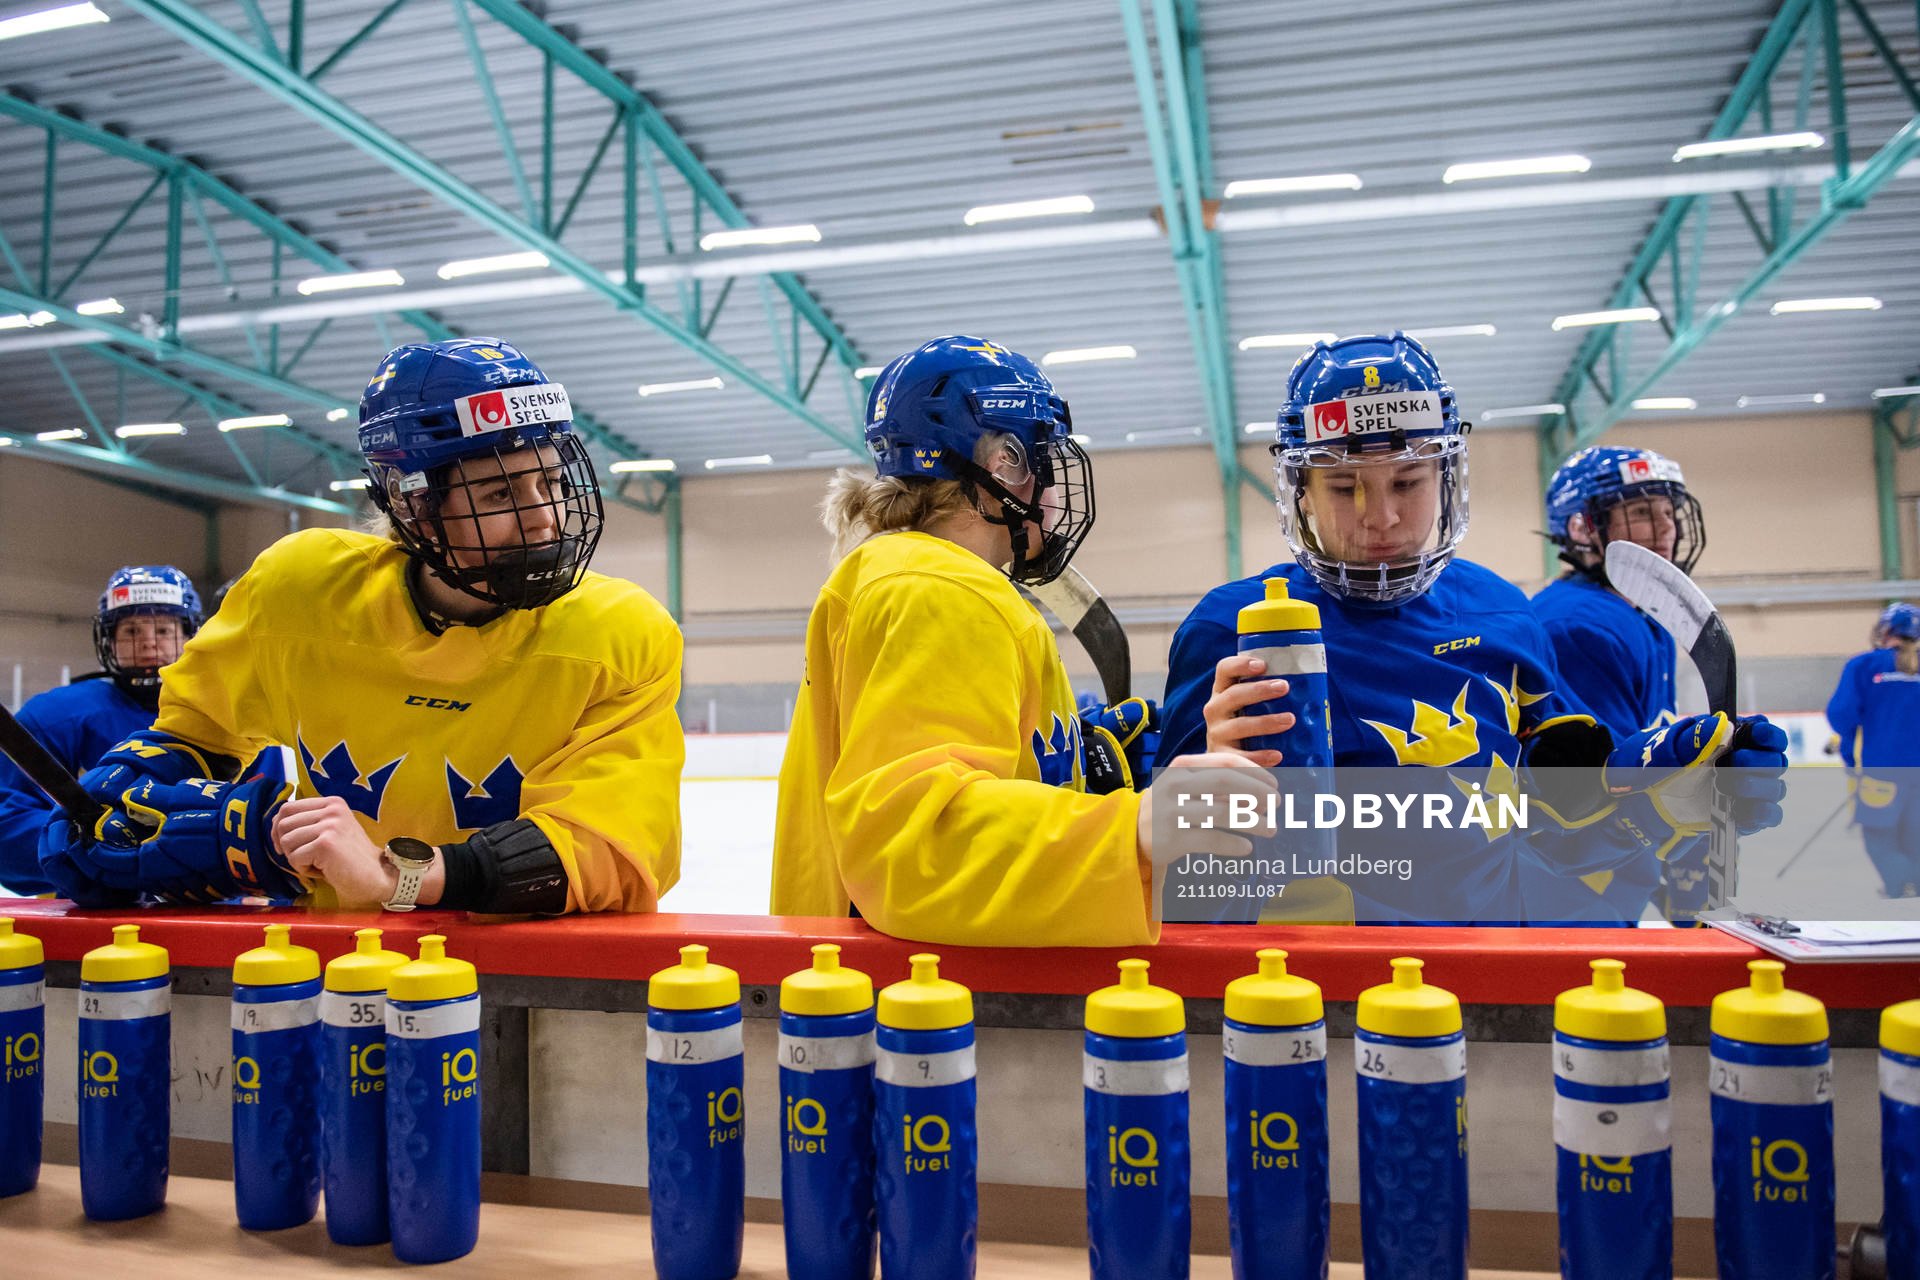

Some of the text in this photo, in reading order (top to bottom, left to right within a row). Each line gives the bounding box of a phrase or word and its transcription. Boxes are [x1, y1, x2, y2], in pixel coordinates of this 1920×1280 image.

[1363, 366, 1381, 387] 8
[1340, 382, 1401, 399] CCM
[982, 399, 1027, 409] CCM
[1353, 399, 1431, 418] SVENSKA
[514, 408, 551, 425] SPEL
[1355, 417, 1397, 433] SPEL
[1002, 496, 1028, 515] CCM
[1433, 635, 1480, 655] CCM
[404, 695, 472, 712] CCM
[1096, 745, 1113, 772] CCM
[1621, 818, 1653, 847] CCM
[242, 1009, 259, 1026] 19.
[350, 1003, 382, 1024] 35.
[397, 1014, 420, 1033] 15.
[5, 1032, 40, 1065] iQ
[674, 1038, 702, 1060] 12.
[789, 1045, 811, 1065] 10.
[1290, 1040, 1312, 1059] 25
[6, 1062, 39, 1083] fuel
[83, 1050, 119, 1082] iQ
[442, 1047, 478, 1087] iQ
[917, 1060, 934, 1079] 9.
[1362, 1049, 1393, 1076] 26.
[84, 1083, 118, 1099] fuel
[351, 1079, 385, 1096] fue
[443, 1082, 477, 1107] fuel
[707, 1087, 742, 1127] iQ
[787, 1095, 828, 1136] iQ
[709, 1122, 742, 1148] fuel
[903, 1114, 951, 1153] iQ
[1250, 1110, 1300, 1150] iQ
[788, 1135, 826, 1154] fuel
[1108, 1125, 1159, 1168] iQ
[904, 1154, 950, 1175] fuel
[1252, 1151, 1299, 1169] fuel
[1751, 1136, 1810, 1182] iQ
[1110, 1167, 1158, 1187] fuel
[1581, 1171, 1632, 1193] fuel
[1753, 1180, 1808, 1203] fuel
